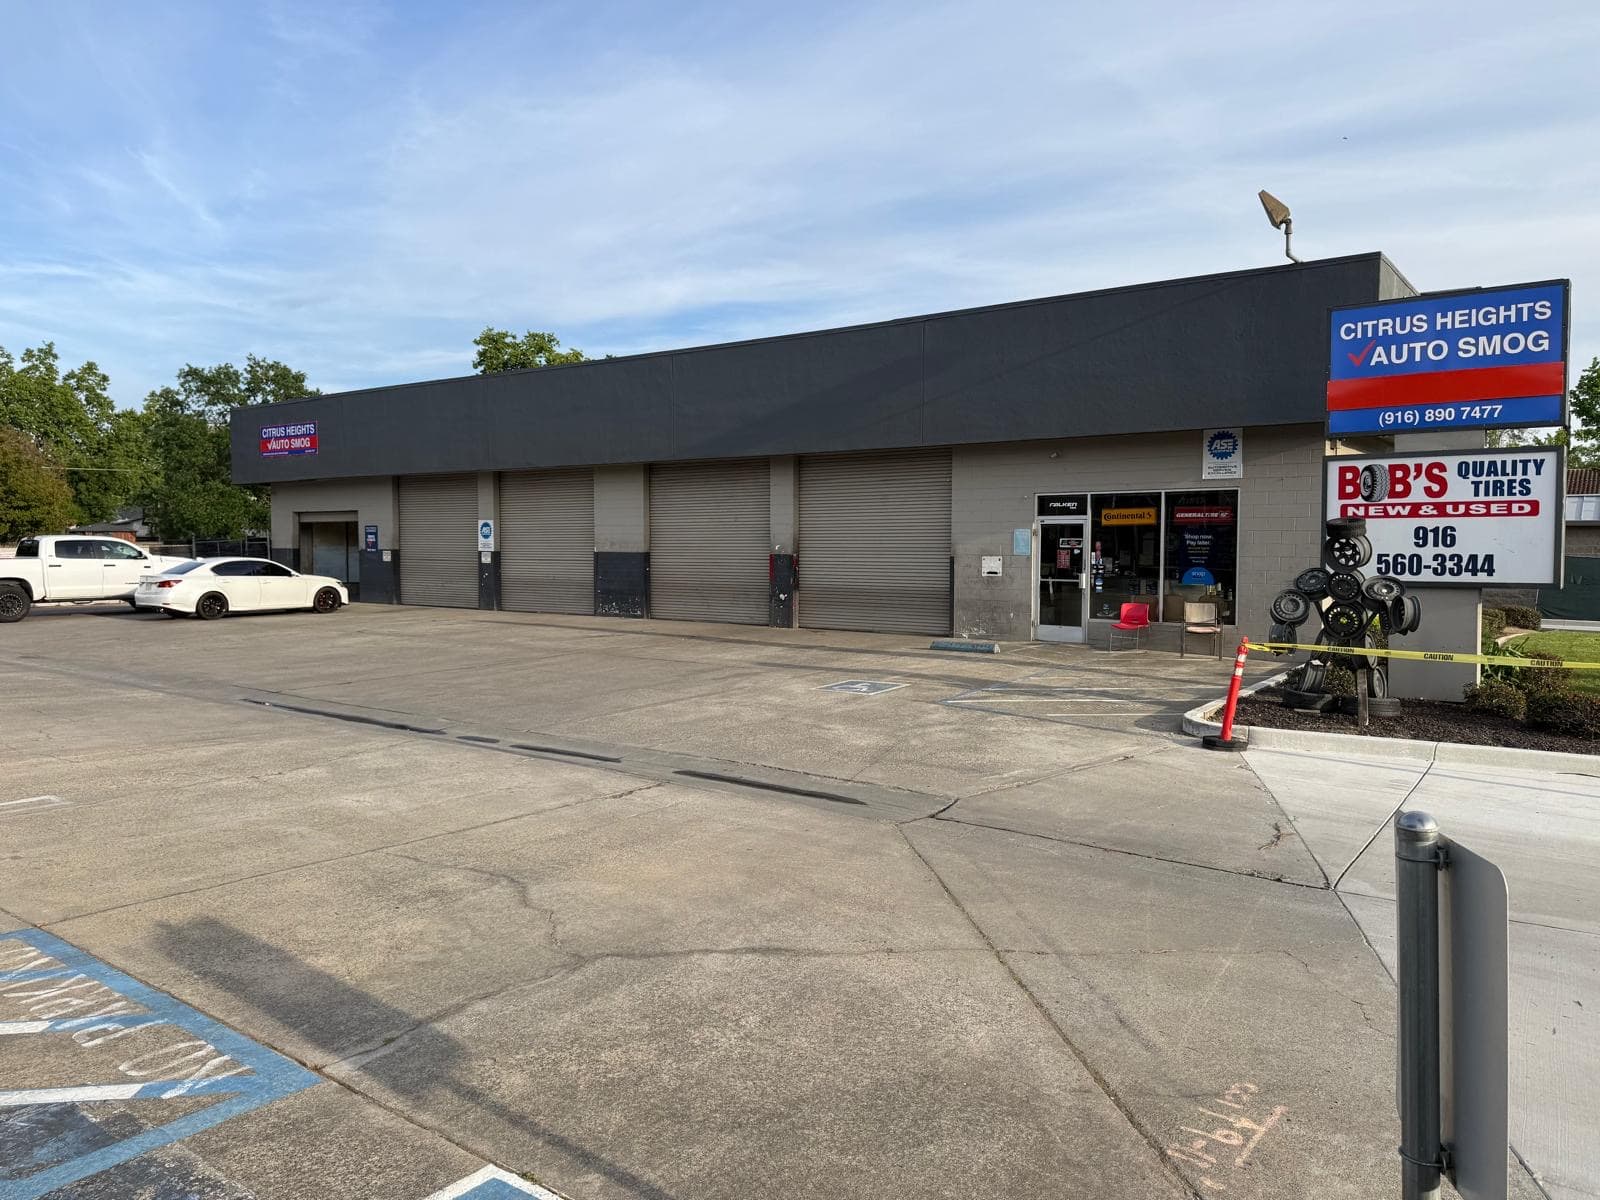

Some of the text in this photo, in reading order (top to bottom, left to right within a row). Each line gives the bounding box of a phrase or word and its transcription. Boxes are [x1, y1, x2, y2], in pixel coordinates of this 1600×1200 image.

[1340, 301, 1552, 340] CITRUS HEIGHTS
[1370, 331, 1550, 366] AUTO SMOG
[1379, 405, 1503, 427] (916) 890 7477
[262, 424, 315, 438] CITRUS HEIGHTS
[272, 438, 310, 450] AUTO SMOG
[1457, 459, 1545, 479] QUALITY
[1471, 478, 1531, 498] TIRES
[1103, 512, 1145, 521] Continental
[1347, 502, 1532, 517] NEW & USED
[1413, 526, 1457, 548] 916
[1376, 553, 1496, 577] 560-3344
[1423, 653, 1454, 661] CAUTION
[1530, 659, 1563, 667] CAUTION
